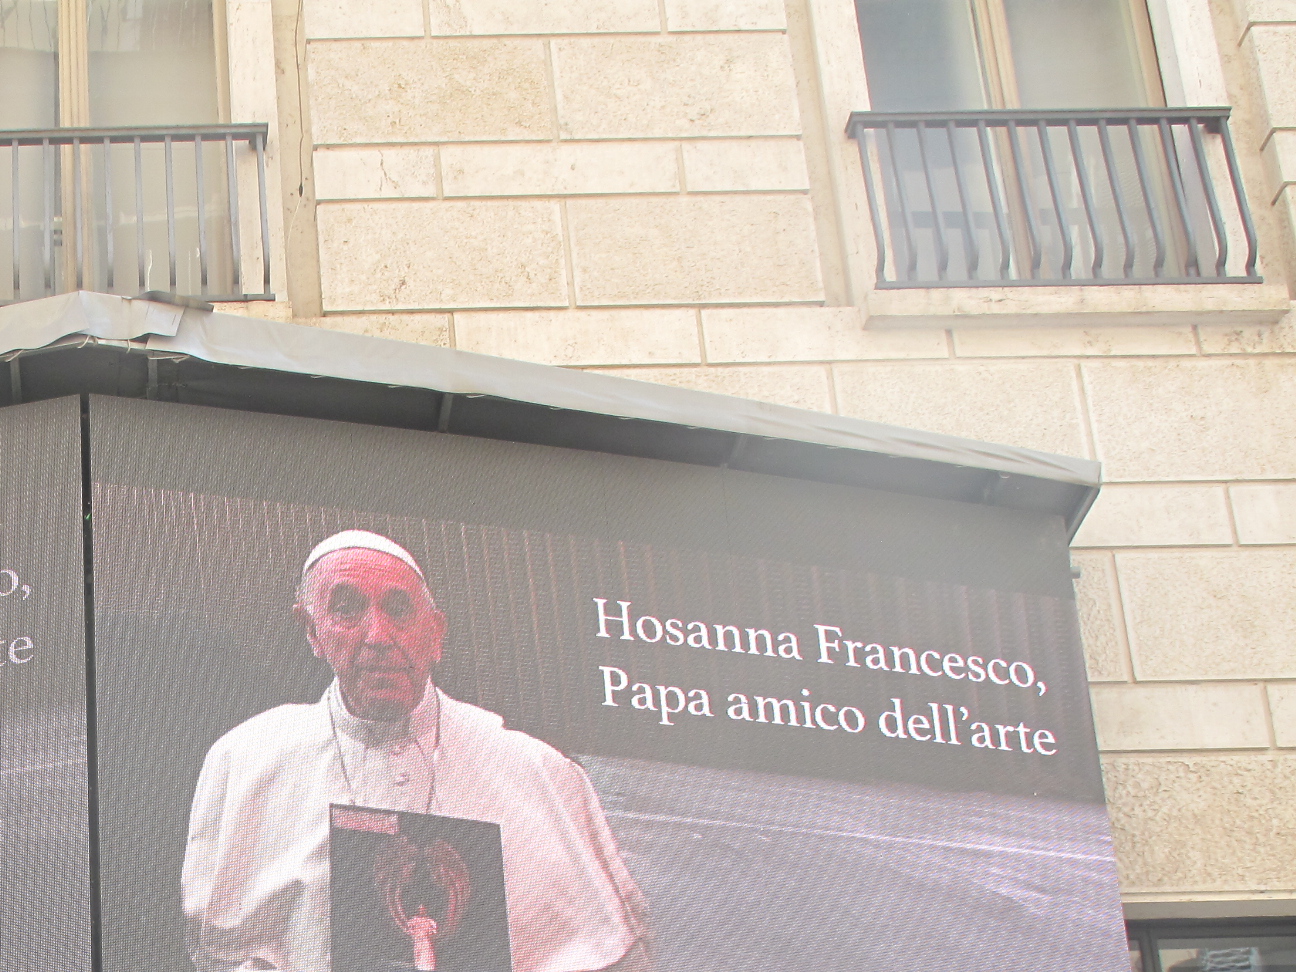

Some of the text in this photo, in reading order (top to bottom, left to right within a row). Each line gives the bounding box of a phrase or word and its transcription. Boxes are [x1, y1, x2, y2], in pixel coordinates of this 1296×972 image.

[593, 598, 1047, 696] Hosanna Francesco,
[599, 665, 714, 725] Papa
[726, 689, 866, 733] amico
